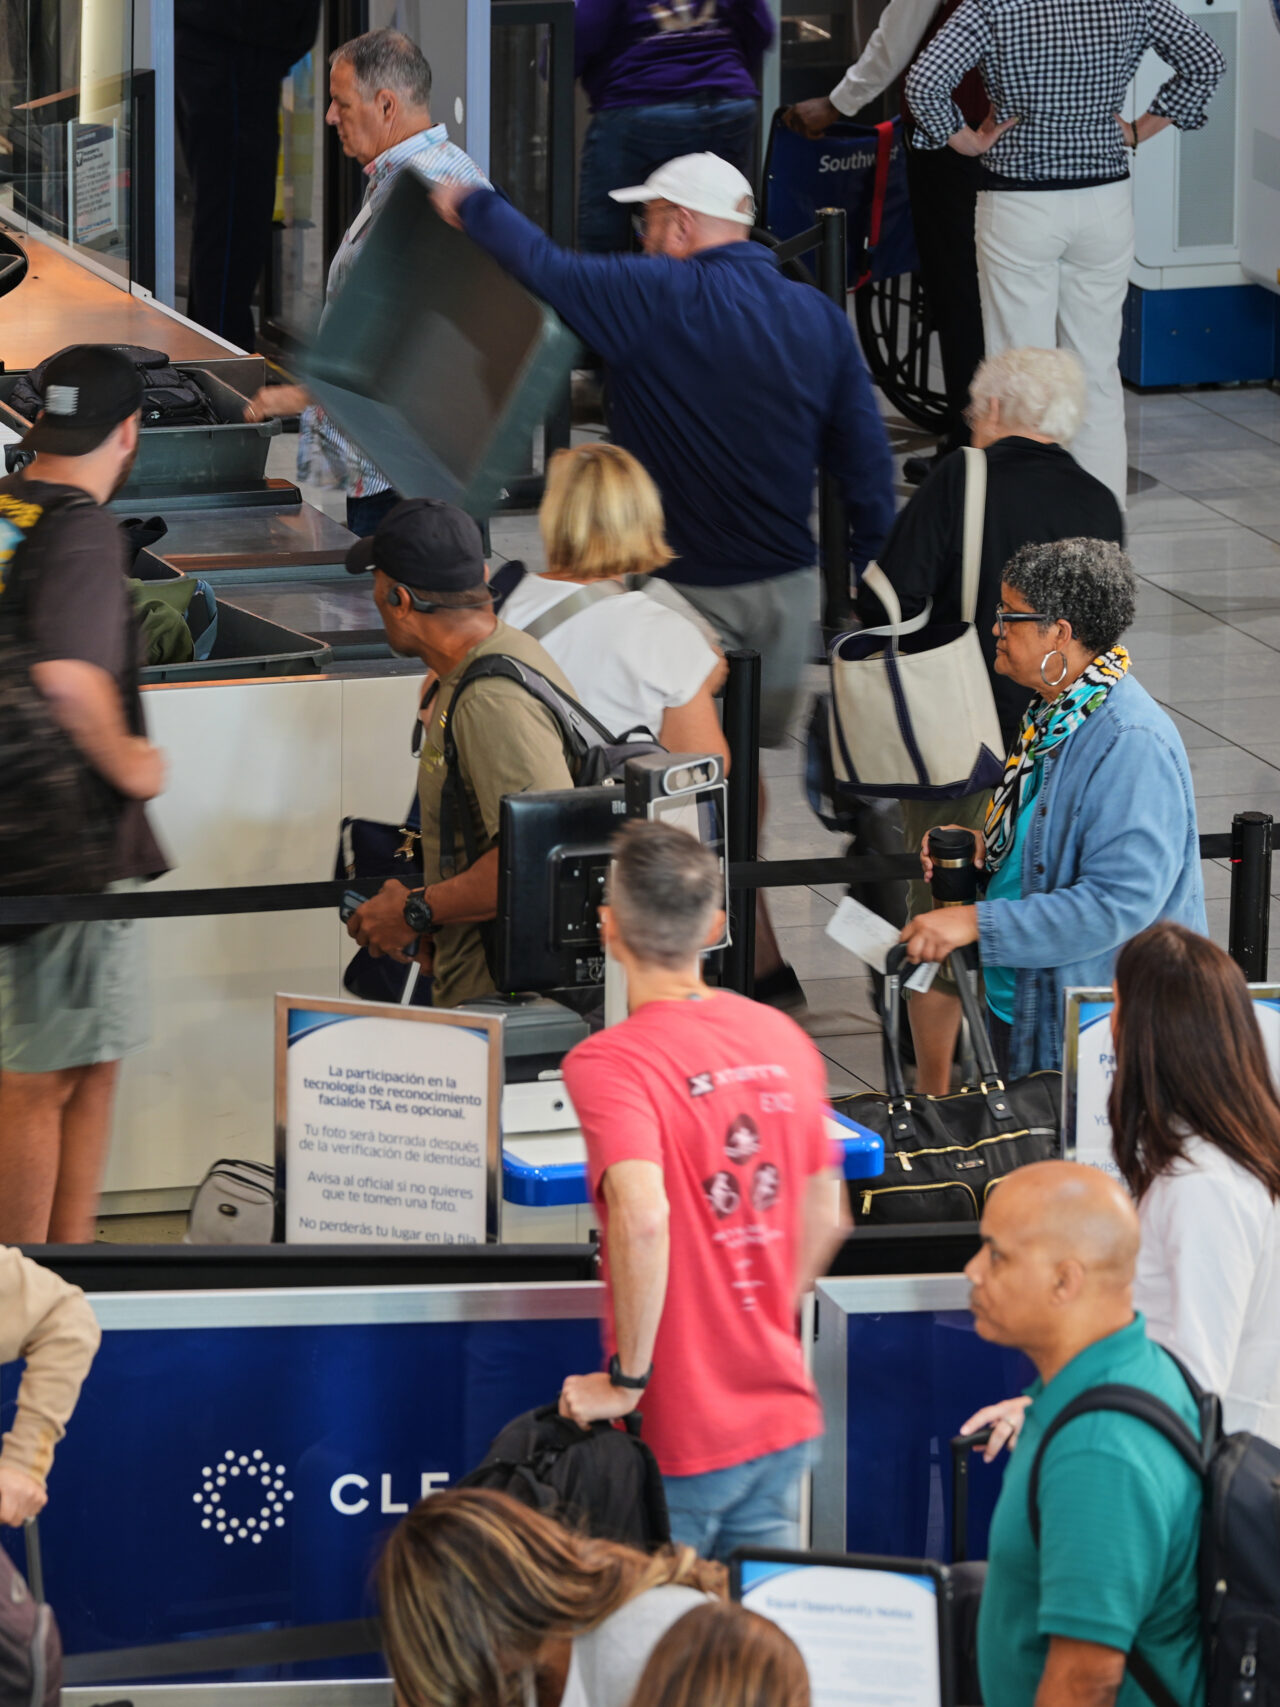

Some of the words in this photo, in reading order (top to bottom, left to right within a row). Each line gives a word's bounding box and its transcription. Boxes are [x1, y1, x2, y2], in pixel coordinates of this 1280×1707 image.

[818, 145, 899, 173] Southwt
[329, 1064, 343, 1077] La
[345, 1068, 425, 1086] participación
[428, 1076, 443, 1088] en
[446, 1076, 457, 1089] la
[318, 1093, 366, 1109] facialde
[369, 1098, 392, 1112] TSA
[395, 1103, 408, 1114] es
[411, 1104, 466, 1120] opcional.
[369, 1084, 384, 1097] de
[387, 1087, 482, 1107] reconocimiento
[304, 1123, 319, 1137] Tu
[322, 1124, 347, 1139] foto
[349, 1129, 375, 1142] será
[378, 1131, 426, 1148] borrada
[429, 1137, 479, 1153] después
[299, 1138, 314, 1151] de
[317, 1138, 328, 1152] la
[331, 1142, 402, 1159] verificación
[405, 1148, 420, 1162] de
[423, 1150, 483, 1169] identidad.
[307, 1170, 341, 1186] Avisa
[343, 1174, 354, 1187] al
[357, 1175, 394, 1191] oficial
[397, 1179, 407, 1193] si
[410, 1183, 426, 1195] no
[428, 1184, 474, 1200] quieres
[322, 1188, 345, 1202] que
[348, 1190, 361, 1202] te
[363, 1191, 402, 1207] tomen
[404, 1197, 428, 1209] una
[431, 1198, 458, 1213] foto.
[299, 1216, 317, 1230] No
[319, 1219, 373, 1236] perderás
[375, 1224, 389, 1237] tu
[391, 1225, 422, 1241] lugar
[425, 1231, 440, 1243] en
[330, 1471, 450, 1515] CLE
